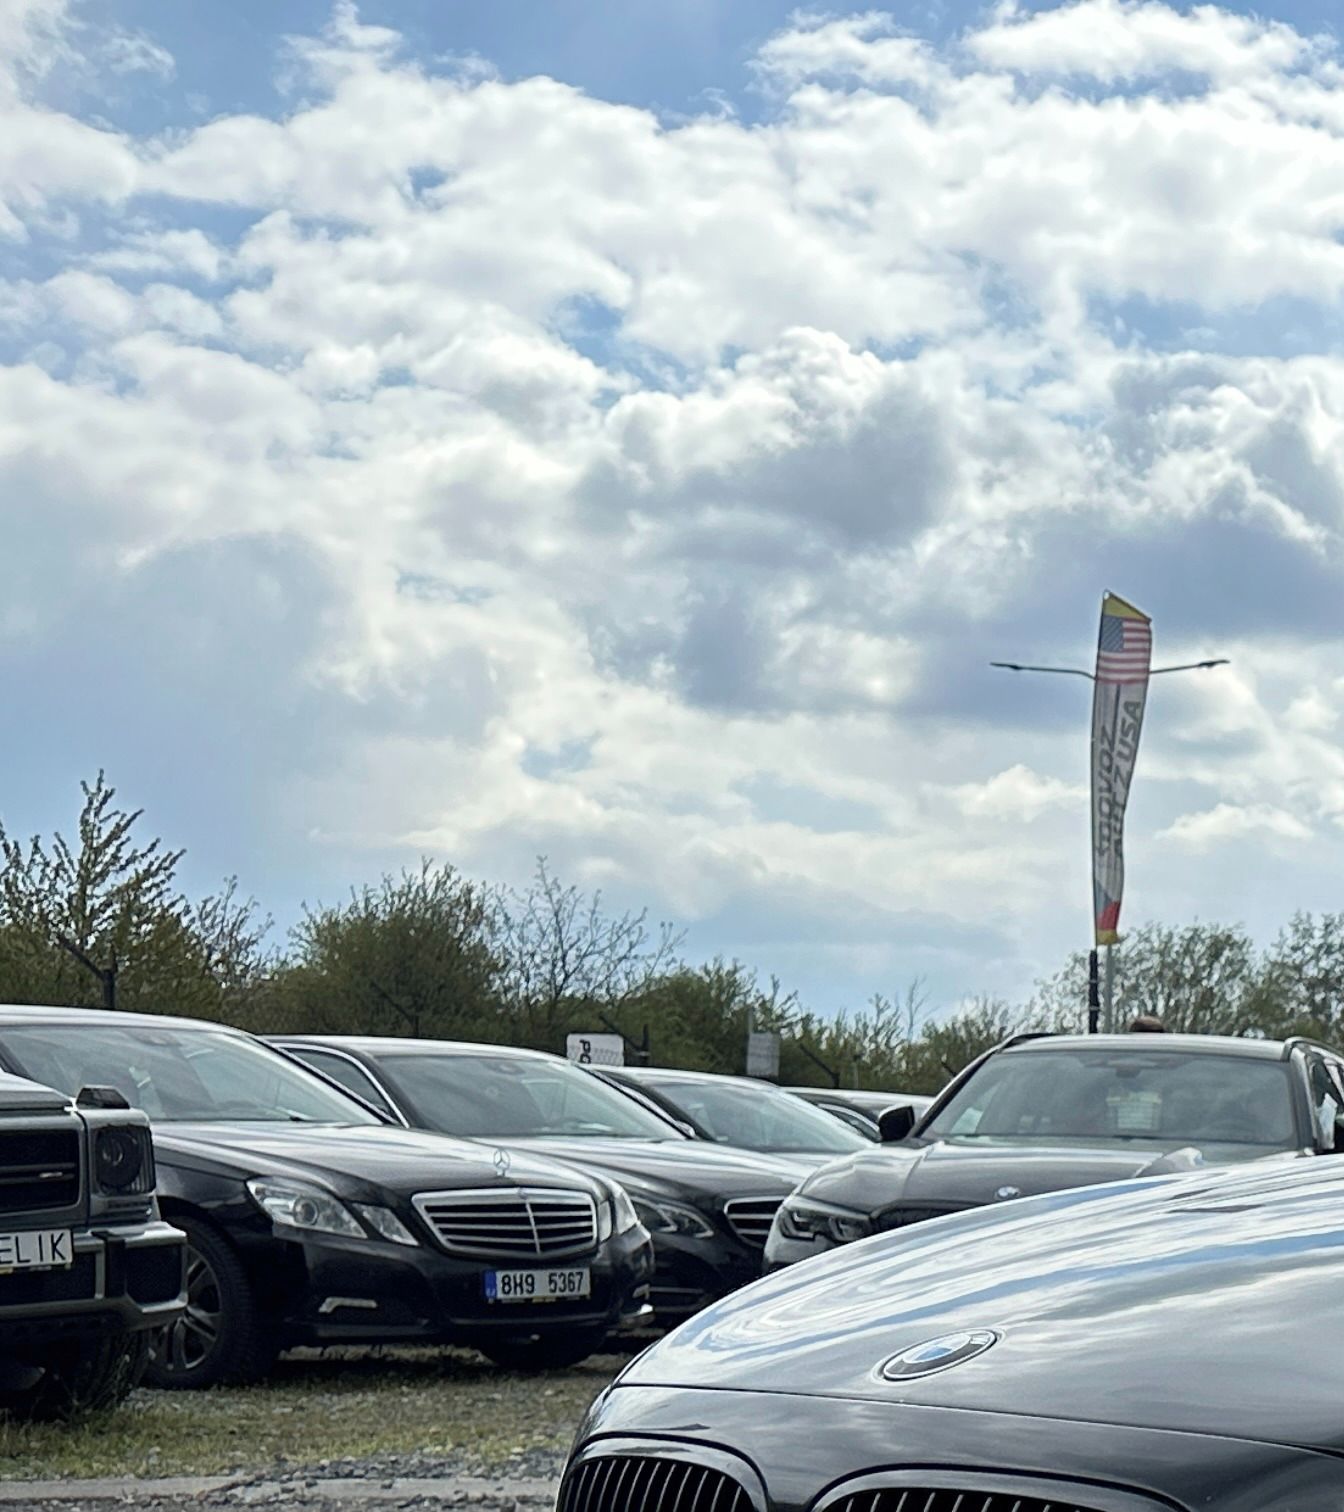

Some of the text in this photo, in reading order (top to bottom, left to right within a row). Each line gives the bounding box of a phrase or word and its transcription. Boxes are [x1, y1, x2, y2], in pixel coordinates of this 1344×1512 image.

[1116, 700, 1142, 762] USA
[501, 1271, 584, 1296] 8H9 5367
